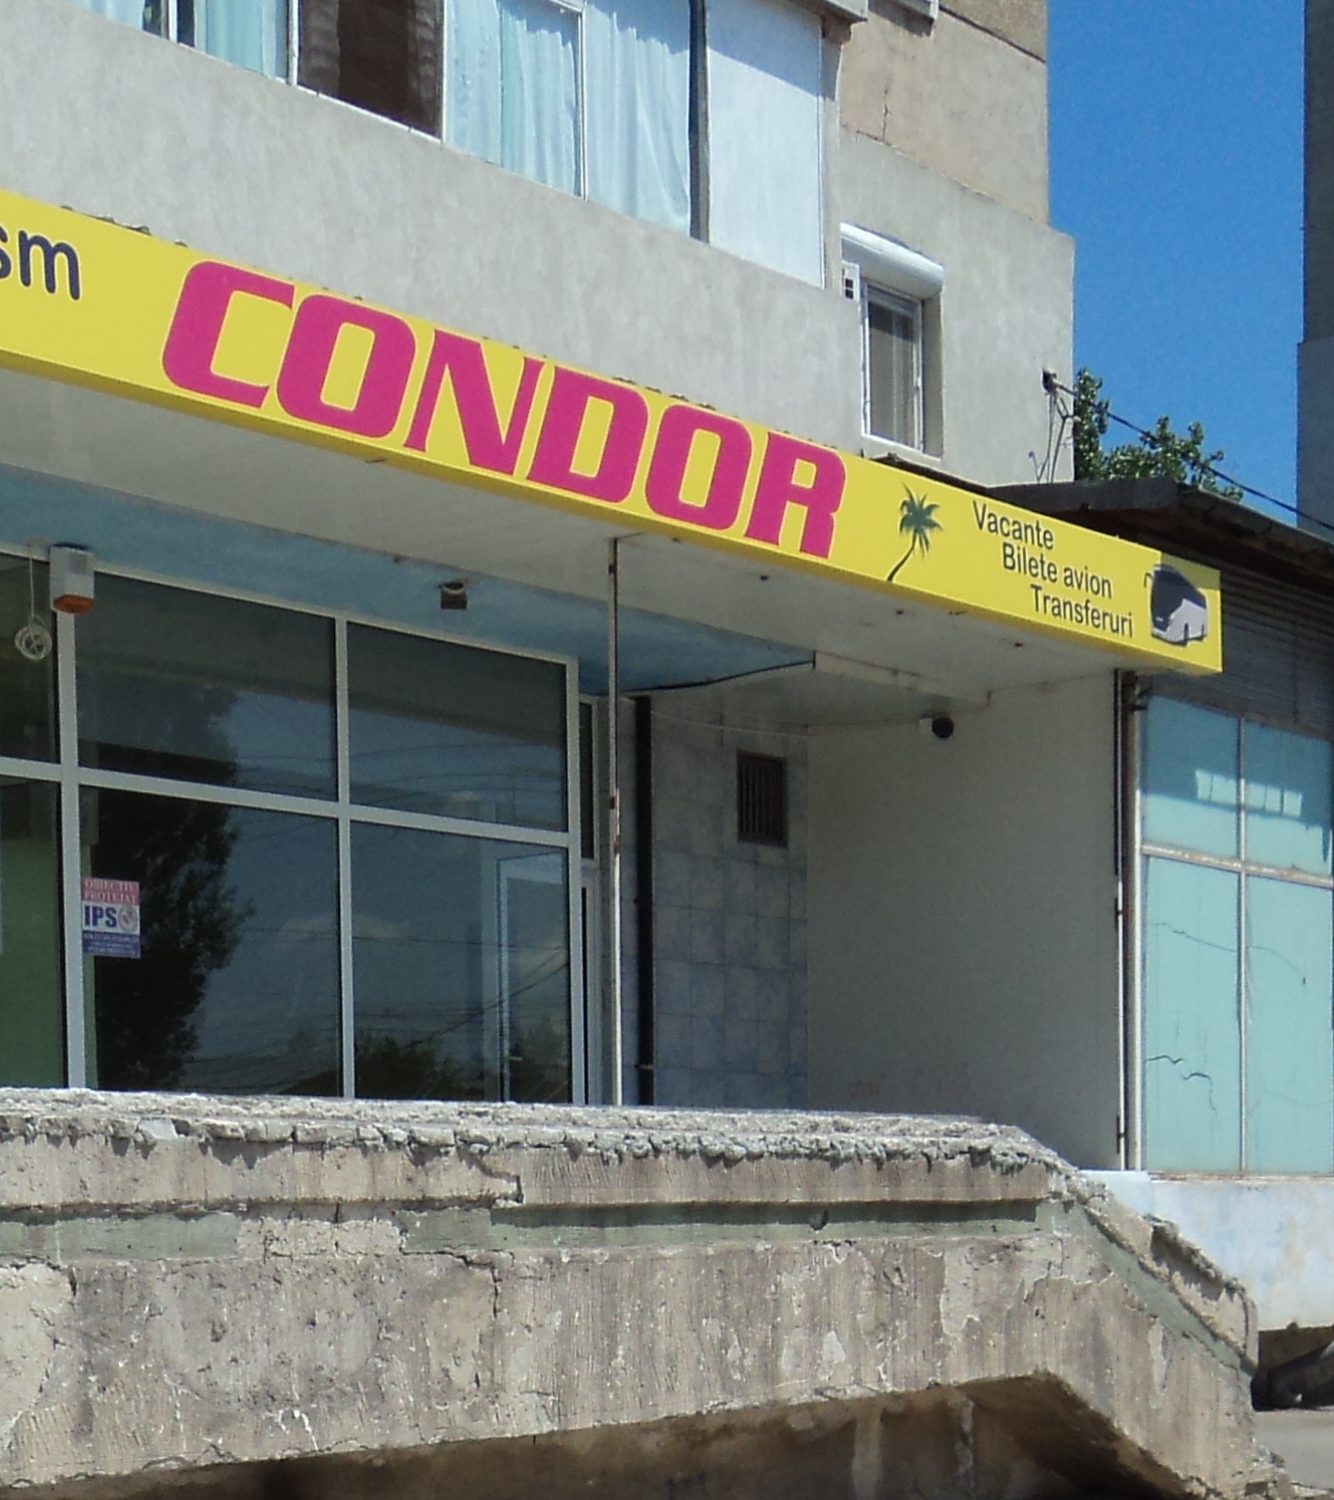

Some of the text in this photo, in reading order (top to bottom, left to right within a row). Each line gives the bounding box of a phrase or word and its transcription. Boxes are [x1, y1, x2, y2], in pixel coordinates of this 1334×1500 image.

[162, 261, 846, 559] CONDOR
[972, 499, 1054, 551] Vacante
[1002, 541, 1113, 600] Bilete avion
[1029, 583, 1134, 638] Transferuri
[84, 905, 117, 928] IPS
